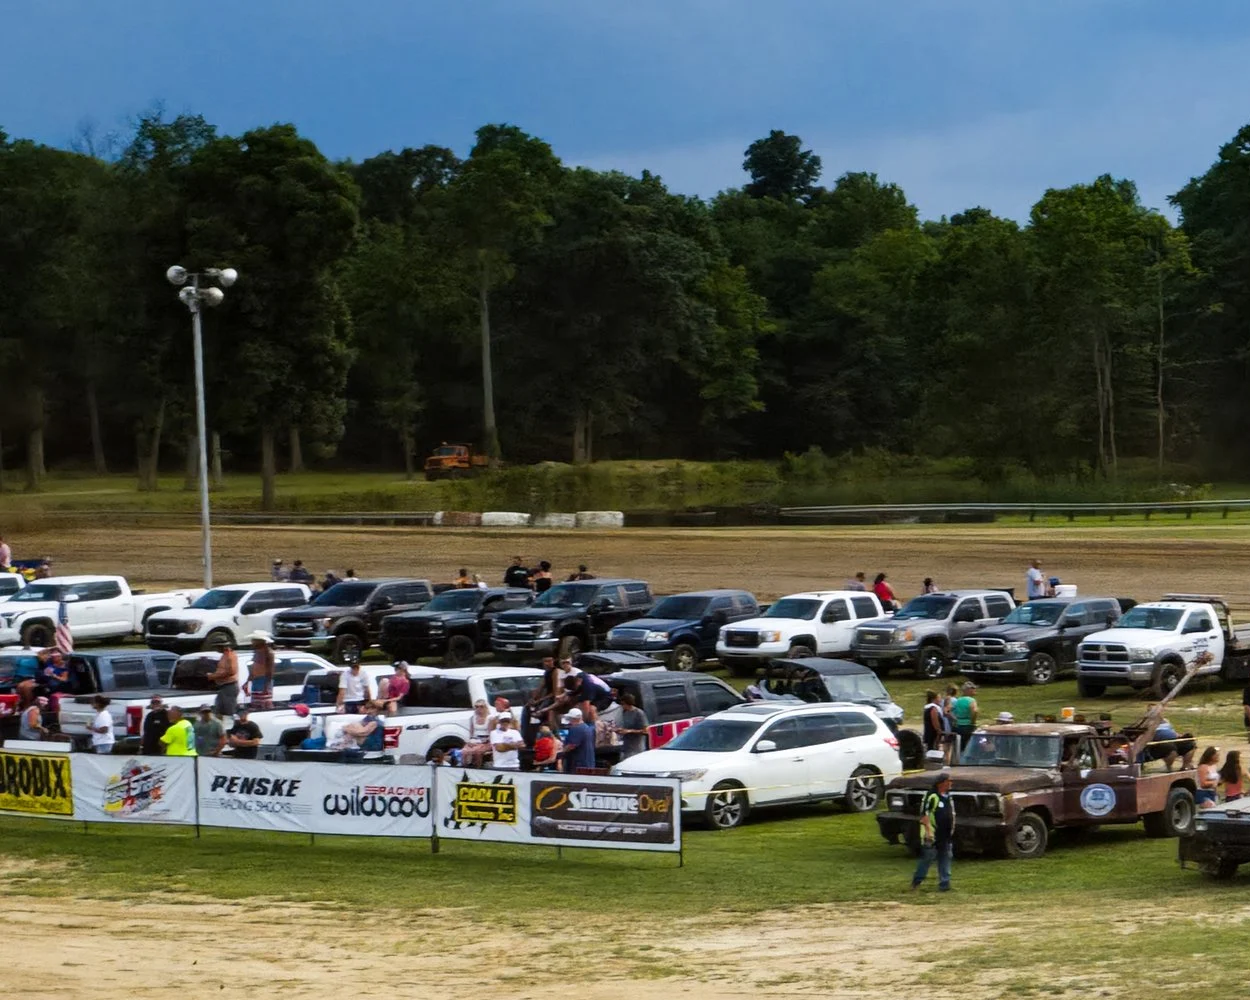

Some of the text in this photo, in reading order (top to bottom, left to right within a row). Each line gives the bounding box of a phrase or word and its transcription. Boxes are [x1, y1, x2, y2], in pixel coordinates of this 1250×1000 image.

[211, 775, 302, 797] PENSKE
[379, 786, 425, 796] RACING
[323, 785, 431, 818] wilwood
